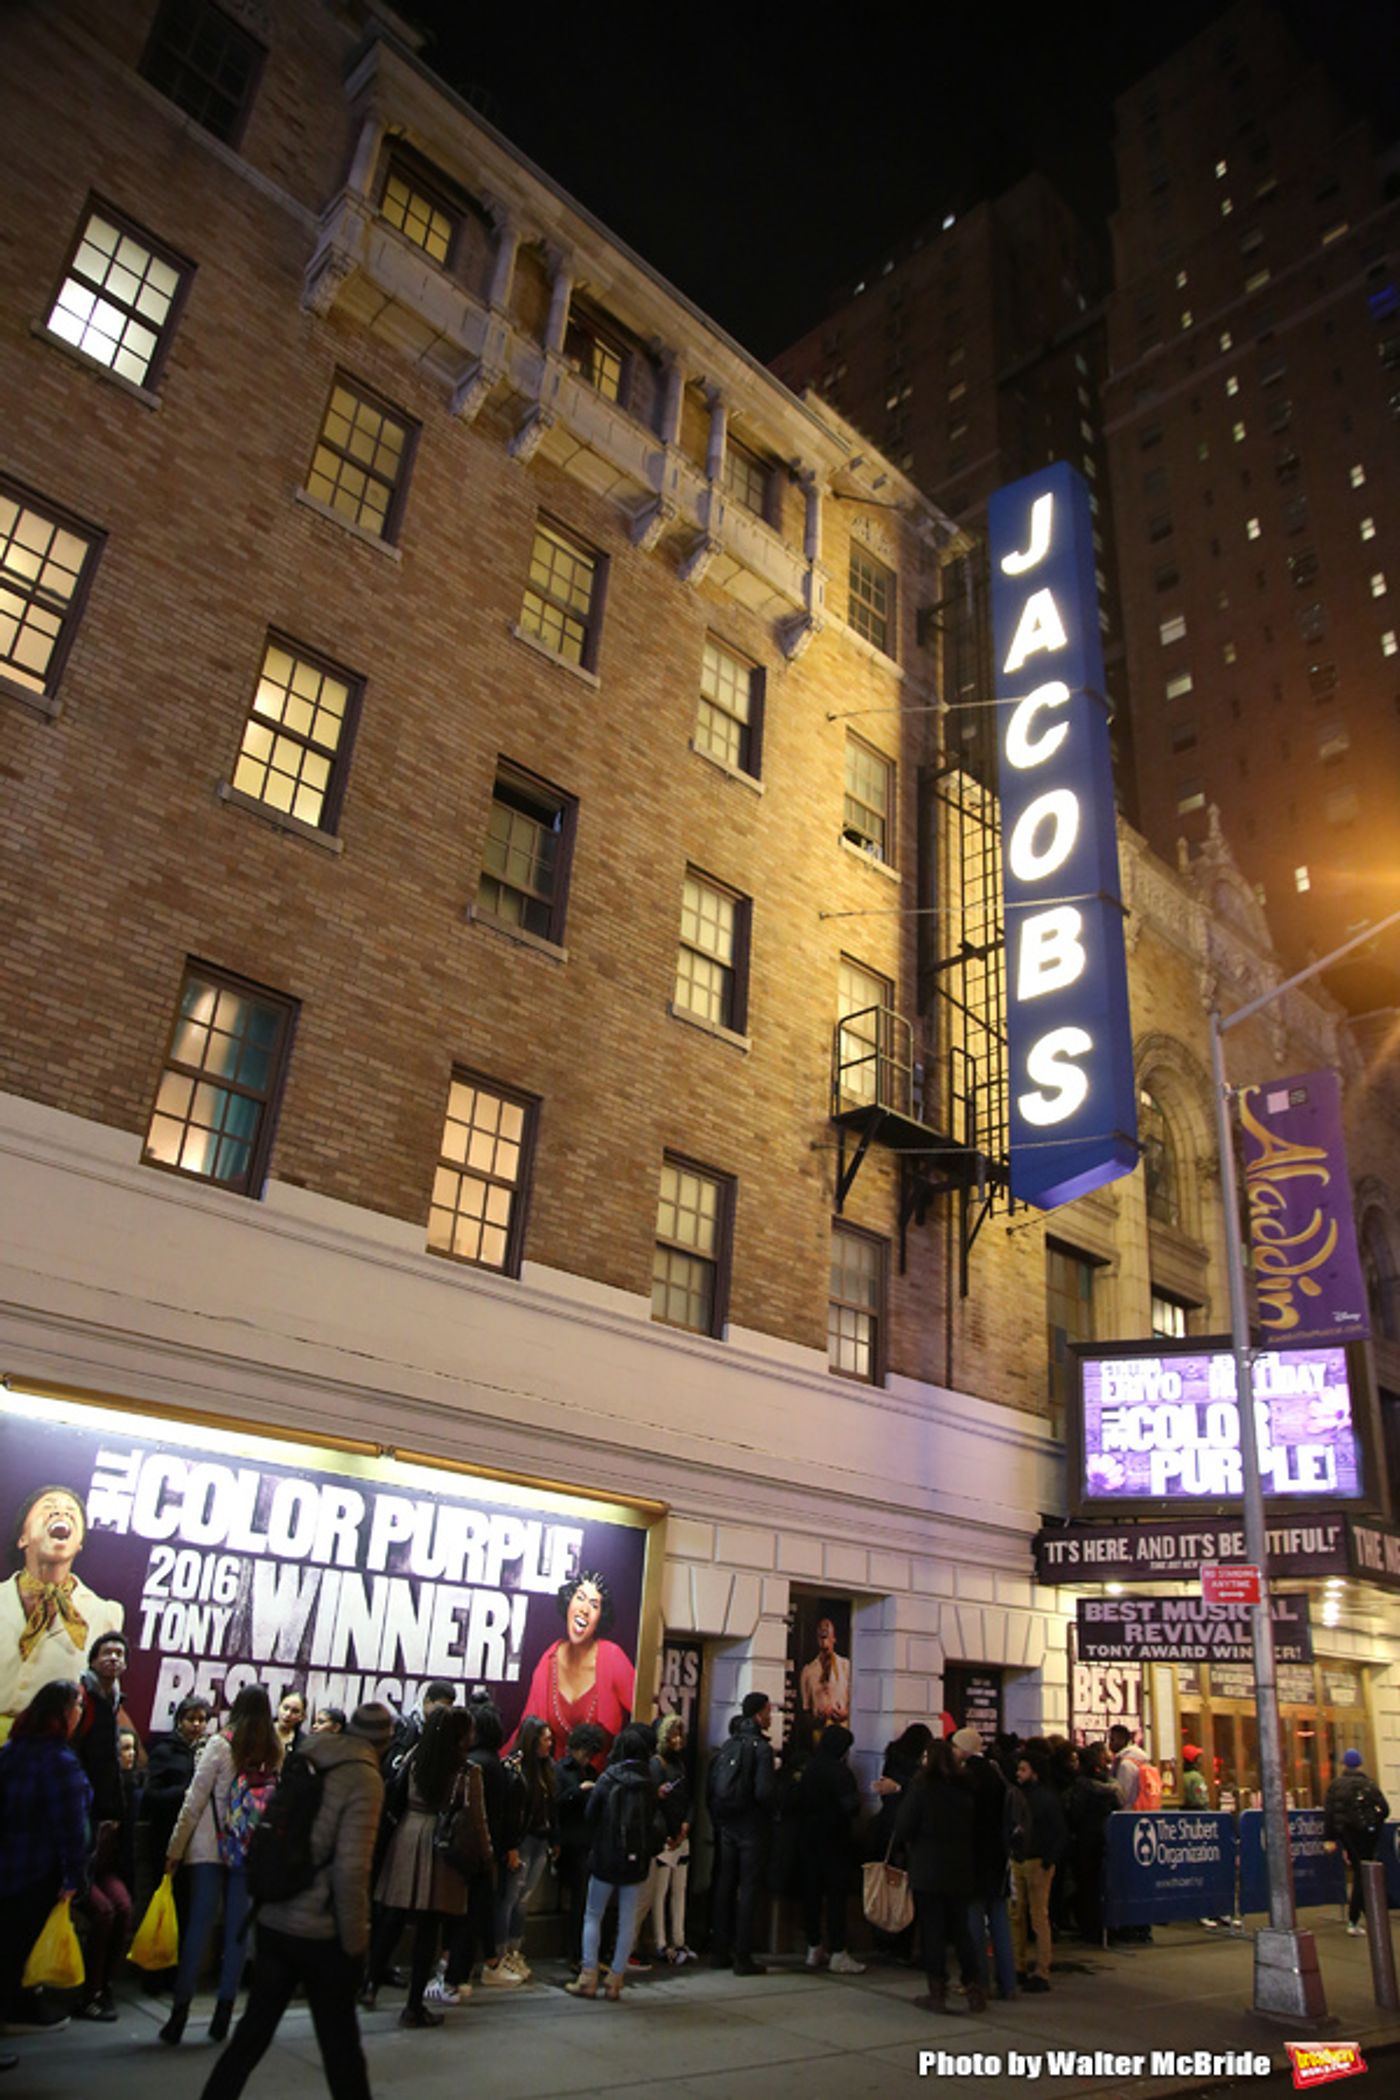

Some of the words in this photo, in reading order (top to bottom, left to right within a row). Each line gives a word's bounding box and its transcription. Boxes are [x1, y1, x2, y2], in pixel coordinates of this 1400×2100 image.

[1001, 492, 1093, 1126] JACOBS
[1239, 1085, 1338, 1330] Aladdin
[86, 1449, 145, 1534] THE
[131, 1454, 366, 1566] COLOR
[366, 1494, 584, 1595] PURPLE
[1083, 1537, 1134, 1563] HERE,
[1137, 1535, 1175, 1560] AND
[1180, 1533, 1215, 1558] IT'S
[143, 1545, 241, 1604] 2016
[139, 1597, 234, 1657] TONY
[251, 1559, 528, 1681] WINNER!
[1085, 1601, 1155, 1622] BEST
[1125, 1623, 1252, 1644] REVIVAL
[1086, 1645, 1134, 1658] TONY
[1139, 1645, 1207, 1659] AWARD
[1213, 1645, 1302, 1660] WINER!
[1073, 1666, 1142, 1715] BEST
[1156, 1818, 1177, 1841] The
[1178, 1816, 1219, 1841] Shubert
[1157, 1841, 1221, 1871] Organization
